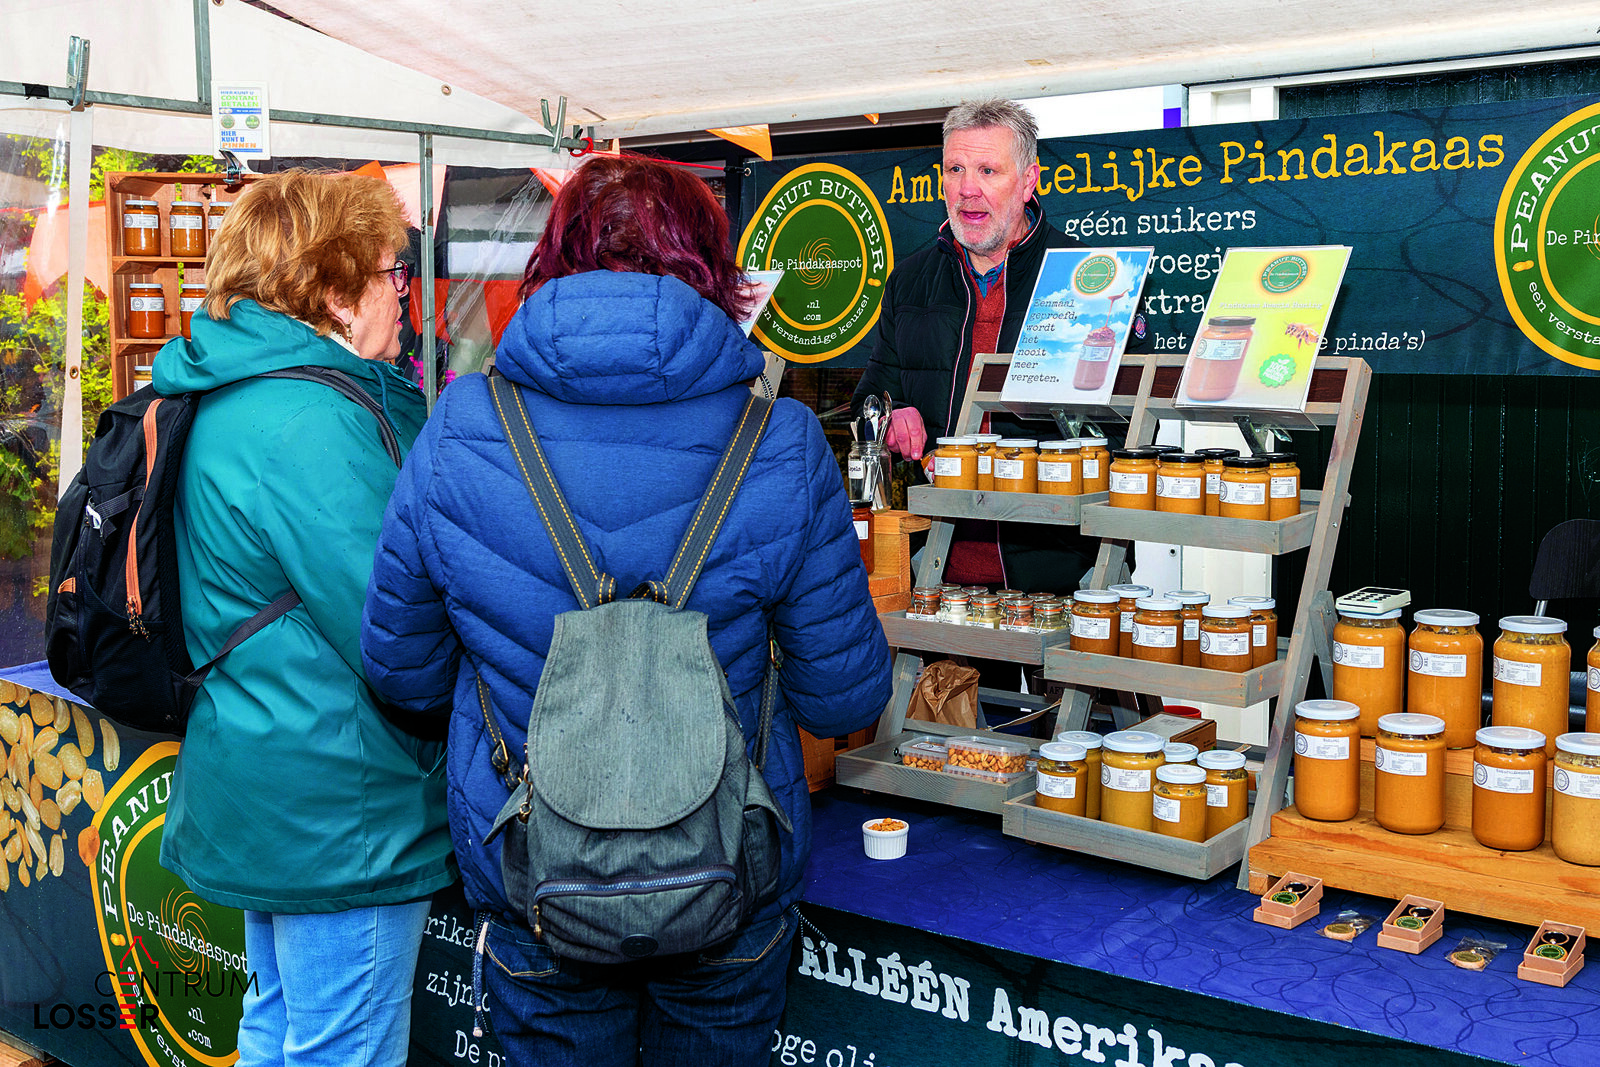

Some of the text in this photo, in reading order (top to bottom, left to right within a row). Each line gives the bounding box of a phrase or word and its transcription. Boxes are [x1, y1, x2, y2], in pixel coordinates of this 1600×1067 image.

[1219, 130, 1505, 184] Pindakaas
[1511, 125, 1600, 253] PEANU
[747, 178, 884, 274] PEANUT BUTTER
[1064, 206, 1257, 241] géén suikers
[1546, 230, 1568, 246] De
[771, 256, 863, 274] De Pindakaaspot
[806, 300, 821, 309] .nl
[1033, 298, 1076, 308] Eenmaal
[1528, 281, 1547, 313] een
[772, 320, 838, 345] verstandige
[839, 294, 870, 333] keuze!
[803, 312, 822, 321] .com
[1029, 311, 1079, 322] geproefd,
[1026, 323, 1056, 332] wordt
[1021, 335, 1039, 344] het
[1154, 331, 1187, 350] het
[1017, 347, 1047, 356] nooit
[1013, 360, 1039, 369] meer
[1010, 374, 1060, 384] vergeten.
[101, 770, 175, 922] PEANU
[127, 901, 248, 974] De Pindakaaspot
[188, 1007, 206, 1025] .nl
[986, 987, 1244, 1067] Amerik
[187, 1027, 213, 1050] .com
[454, 1028, 481, 1064] De
